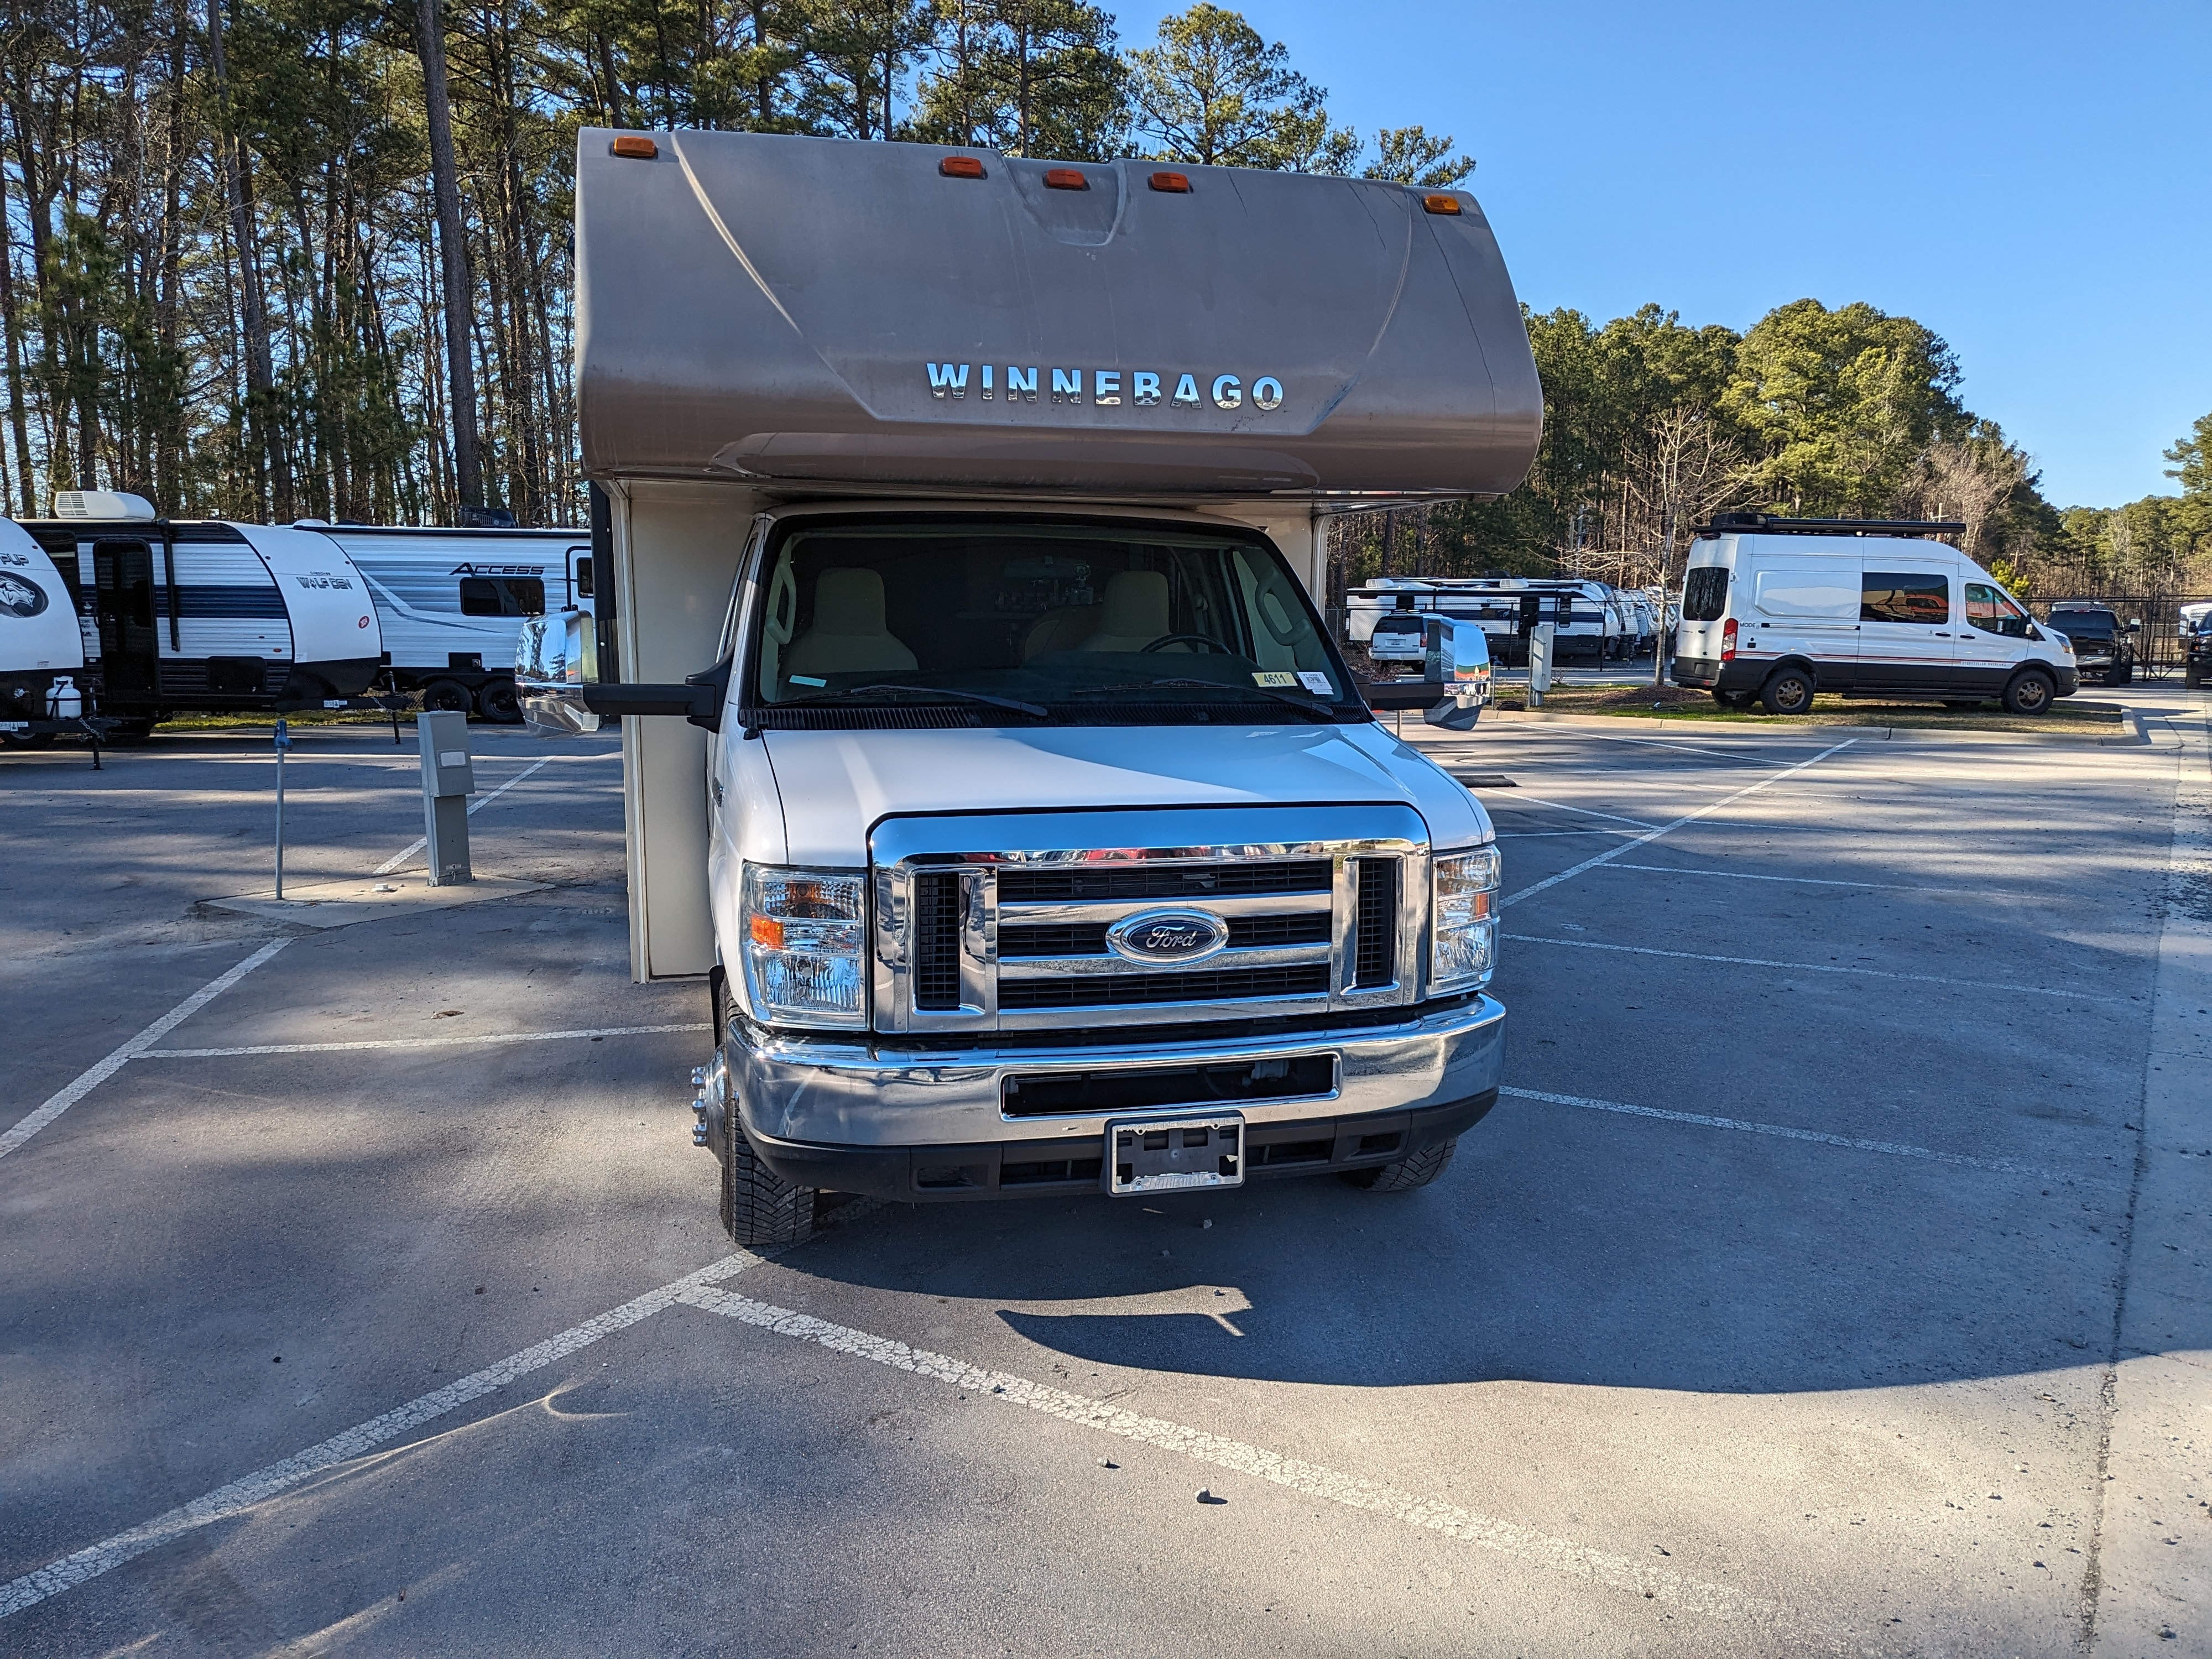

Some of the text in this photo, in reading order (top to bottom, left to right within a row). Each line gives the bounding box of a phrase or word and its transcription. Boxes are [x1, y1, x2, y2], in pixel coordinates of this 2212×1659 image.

[926, 363, 1284, 411] WINNEBAGO
[328, 578, 353, 590] DEN
[1264, 674, 1287, 685] 4611
[1146, 926, 1197, 948] Ford
[1117, 1119, 1203, 1132] EXPERIENCE
